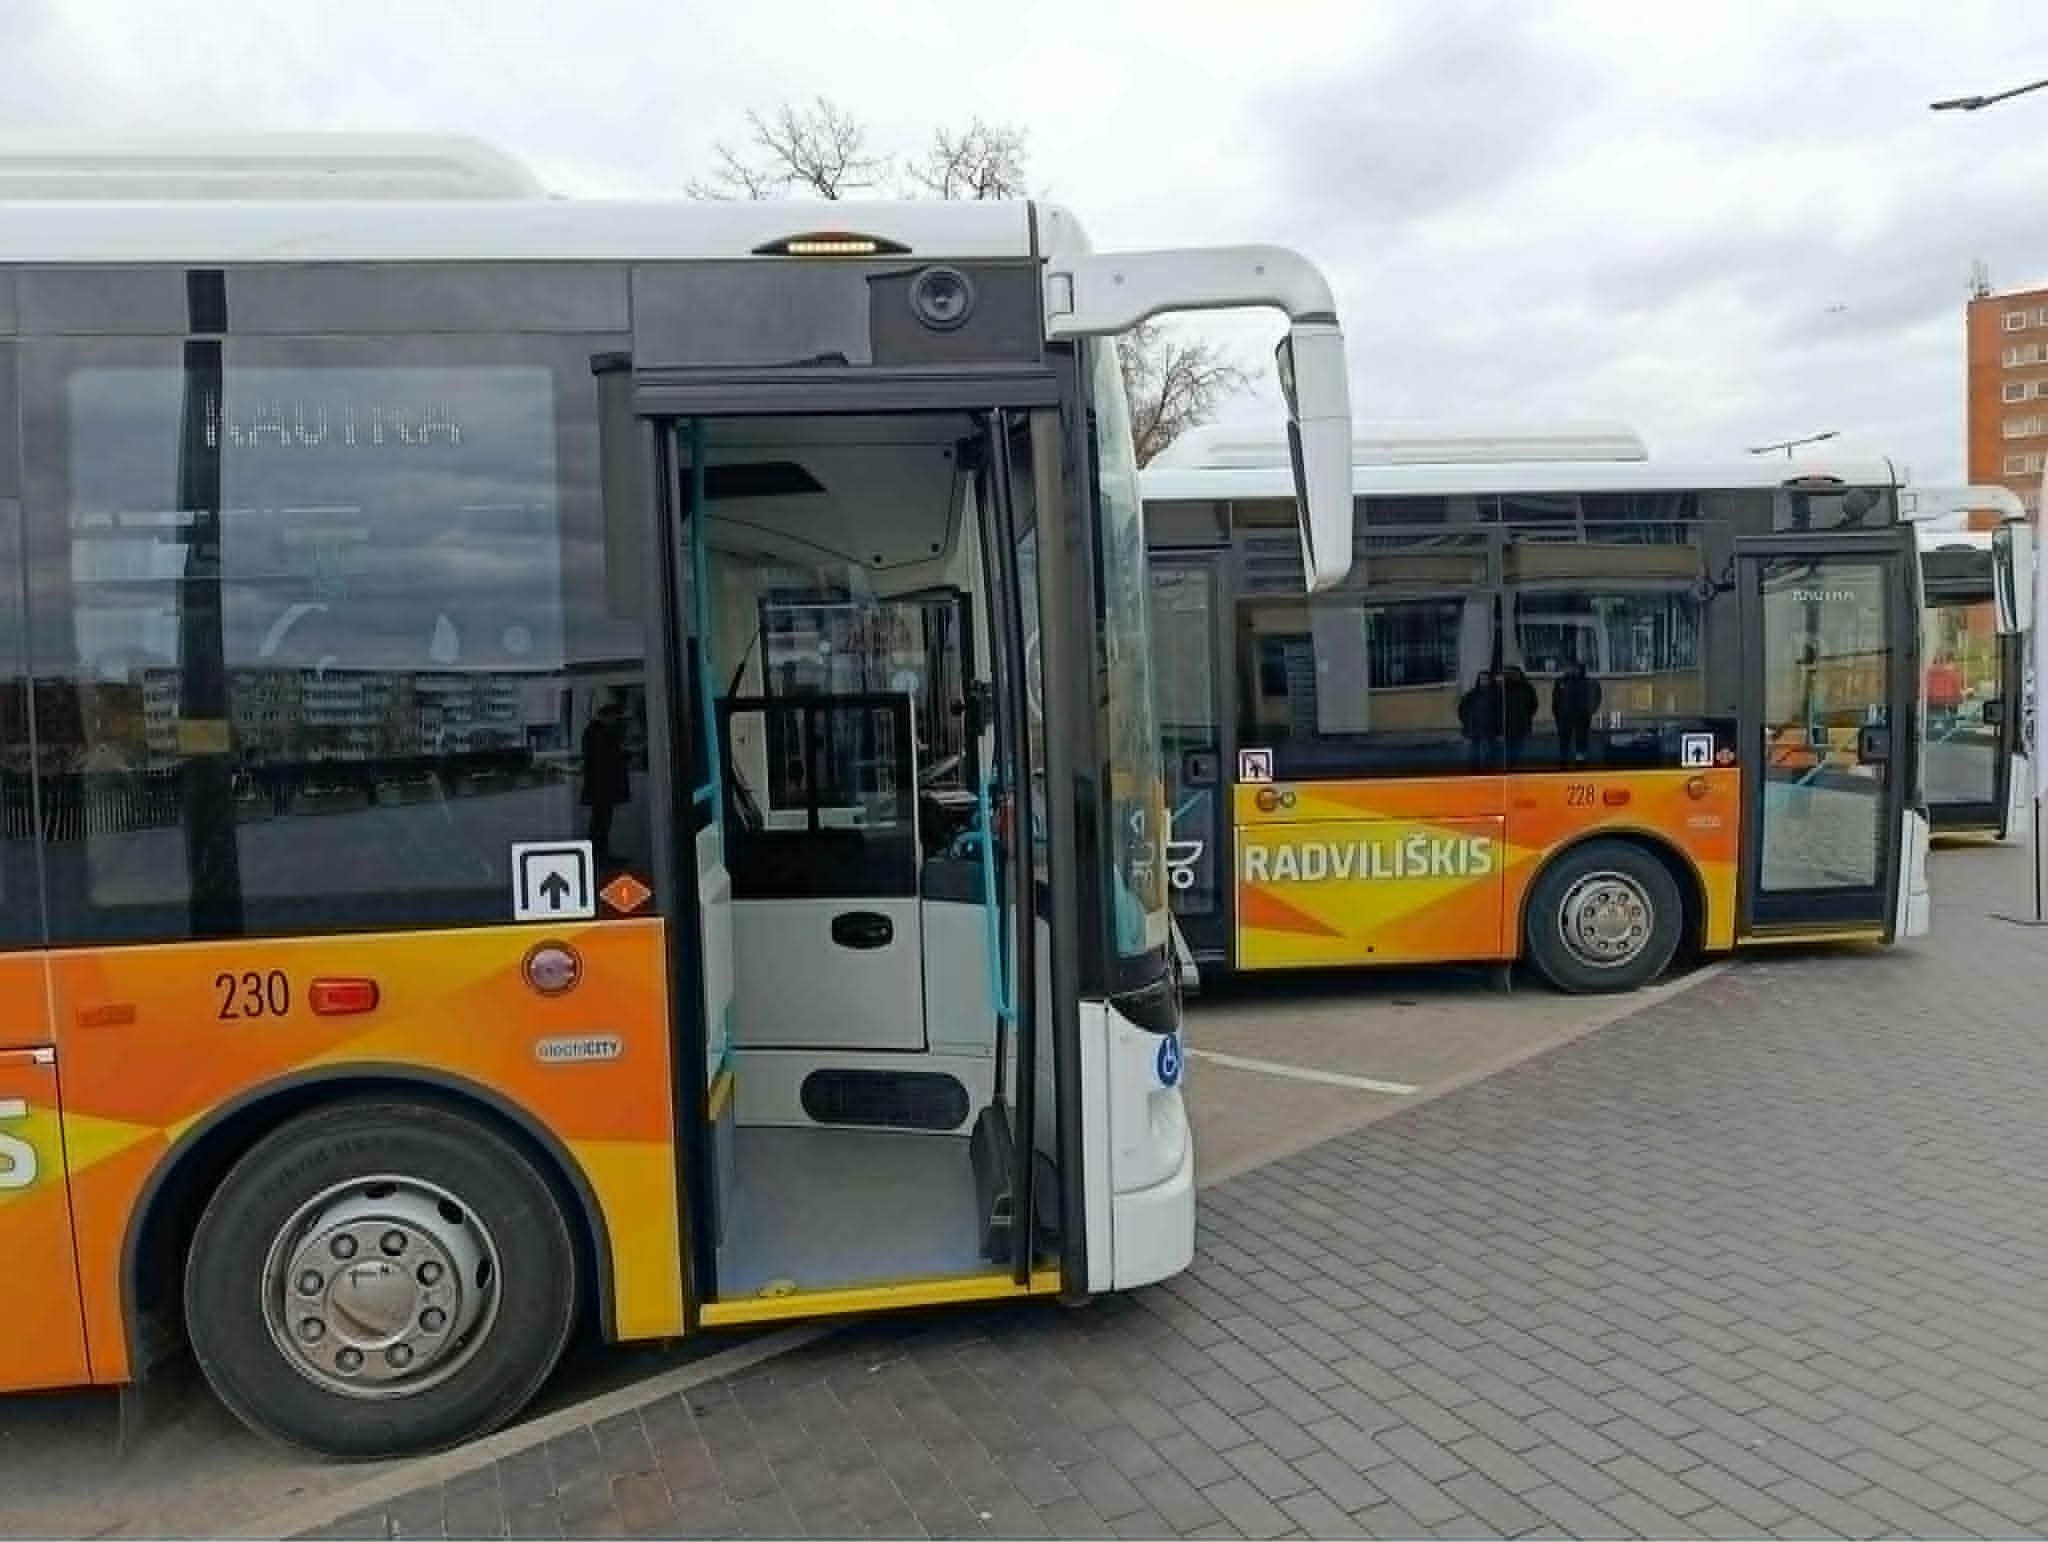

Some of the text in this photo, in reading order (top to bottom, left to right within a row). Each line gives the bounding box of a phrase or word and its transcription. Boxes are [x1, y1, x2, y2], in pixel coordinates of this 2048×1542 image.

[1567, 784, 1594, 807] 228
[1244, 832, 1493, 881] RADVILIŠKIS
[216, 970, 290, 1019] 230
